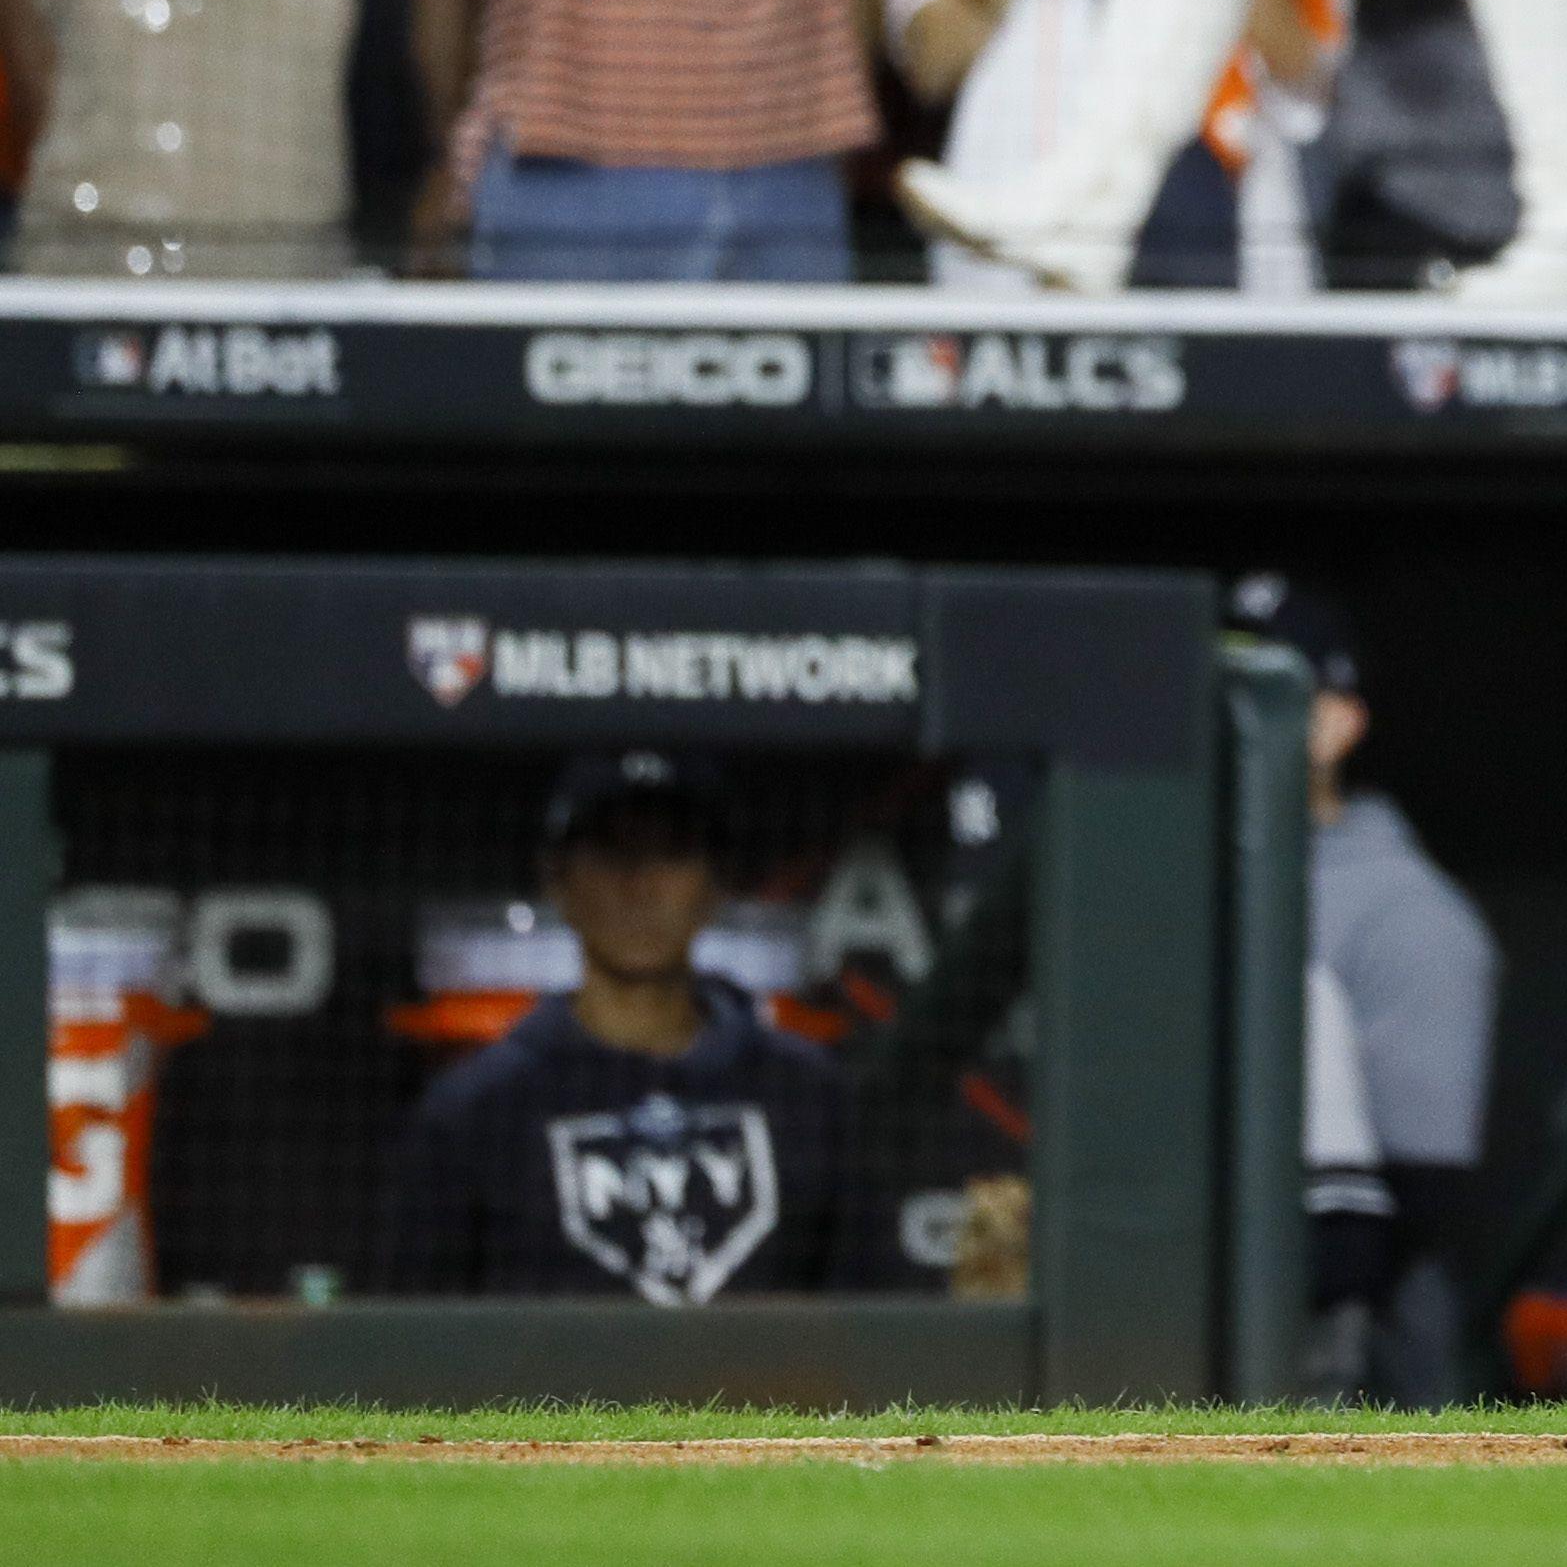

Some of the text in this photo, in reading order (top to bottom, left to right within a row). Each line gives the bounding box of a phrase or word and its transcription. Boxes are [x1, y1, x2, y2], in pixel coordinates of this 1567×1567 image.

[526, 332, 1186, 410] GEICO ALCS
[494, 632, 917, 702] MLB NETWORK
